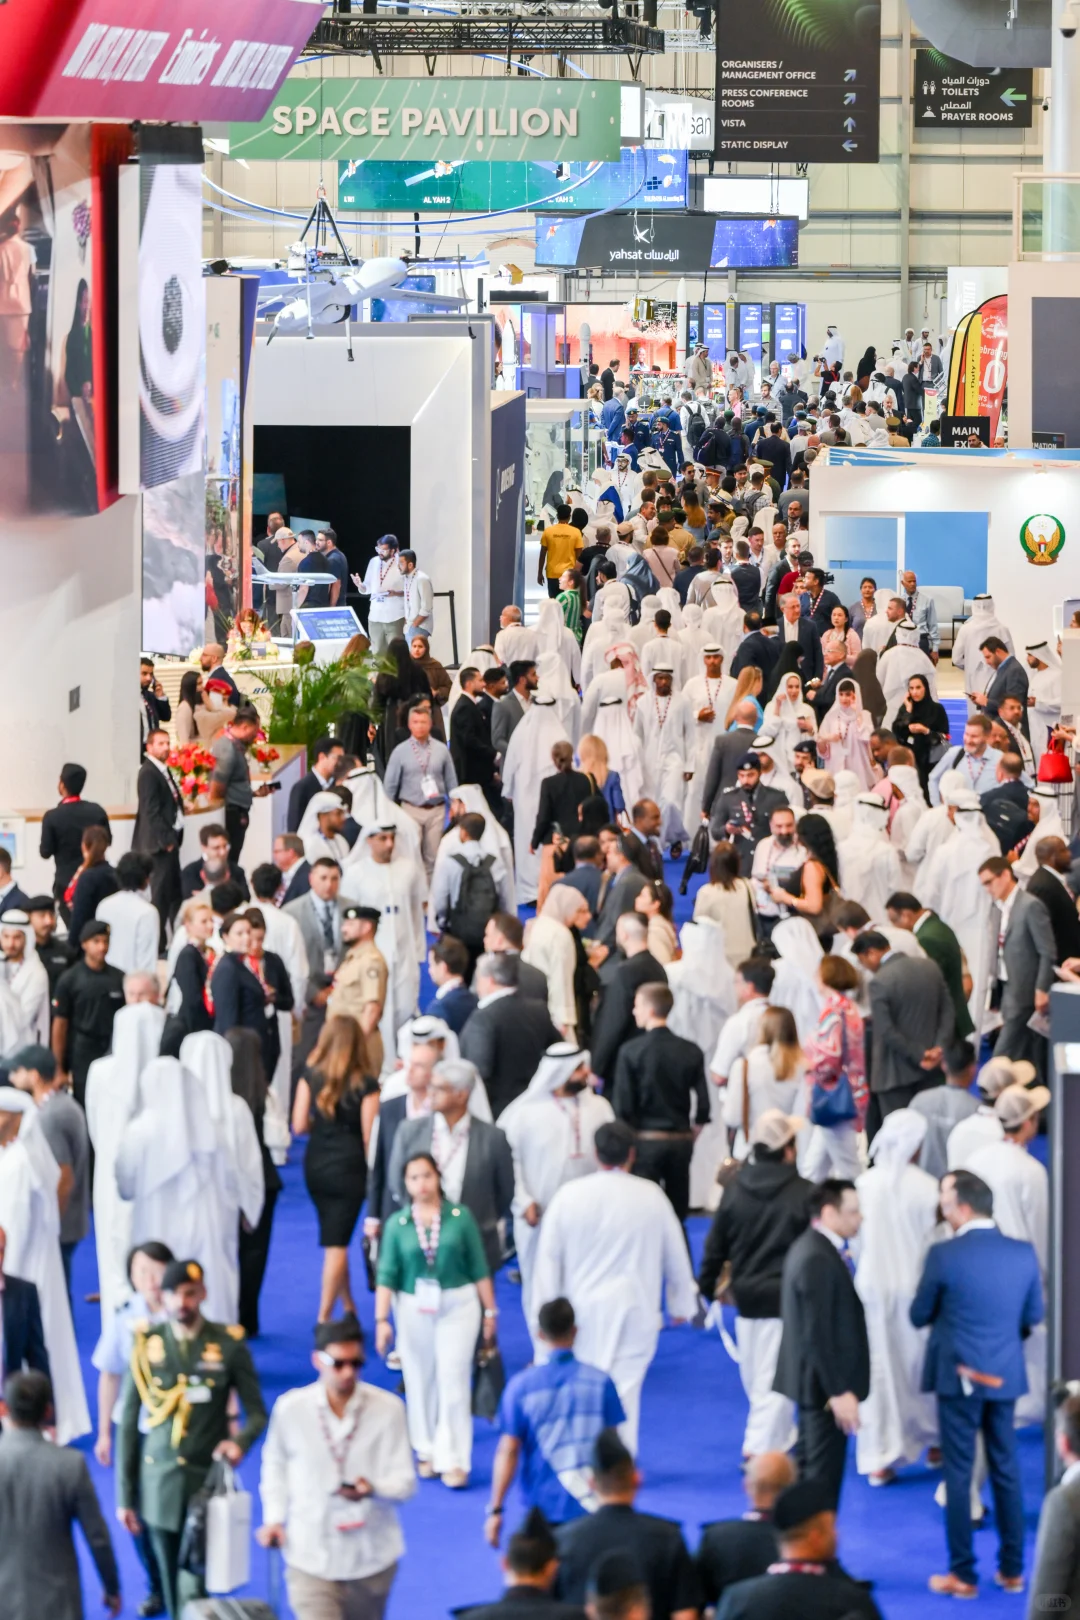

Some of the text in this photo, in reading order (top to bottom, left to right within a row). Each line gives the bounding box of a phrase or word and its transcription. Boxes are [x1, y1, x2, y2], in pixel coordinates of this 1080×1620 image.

[721, 60, 783, 69] ORGANISERS /
[721, 71, 816, 80] MANAGEMENT OFFICE
[941, 76, 990, 86] دورات المياه
[721, 89, 808, 98] PRESS CONFERENCE
[941, 88, 979, 96] TOILETS
[721, 99, 755, 108] ROOMS
[940, 101, 972, 111] المصلى
[941, 112, 1014, 121] PRAYER ROOMS
[272, 106, 579, 138] SPACE PAVILION
[691, 115, 712, 135] san
[721, 119, 746, 127] VISTA
[721, 140, 788, 149] STATIC DISPLAY
[609, 248, 643, 262] yahsat
[978, 394, 988, 402] ars
[951, 426, 980, 436] MAIN
[953, 440, 970, 448] EX
